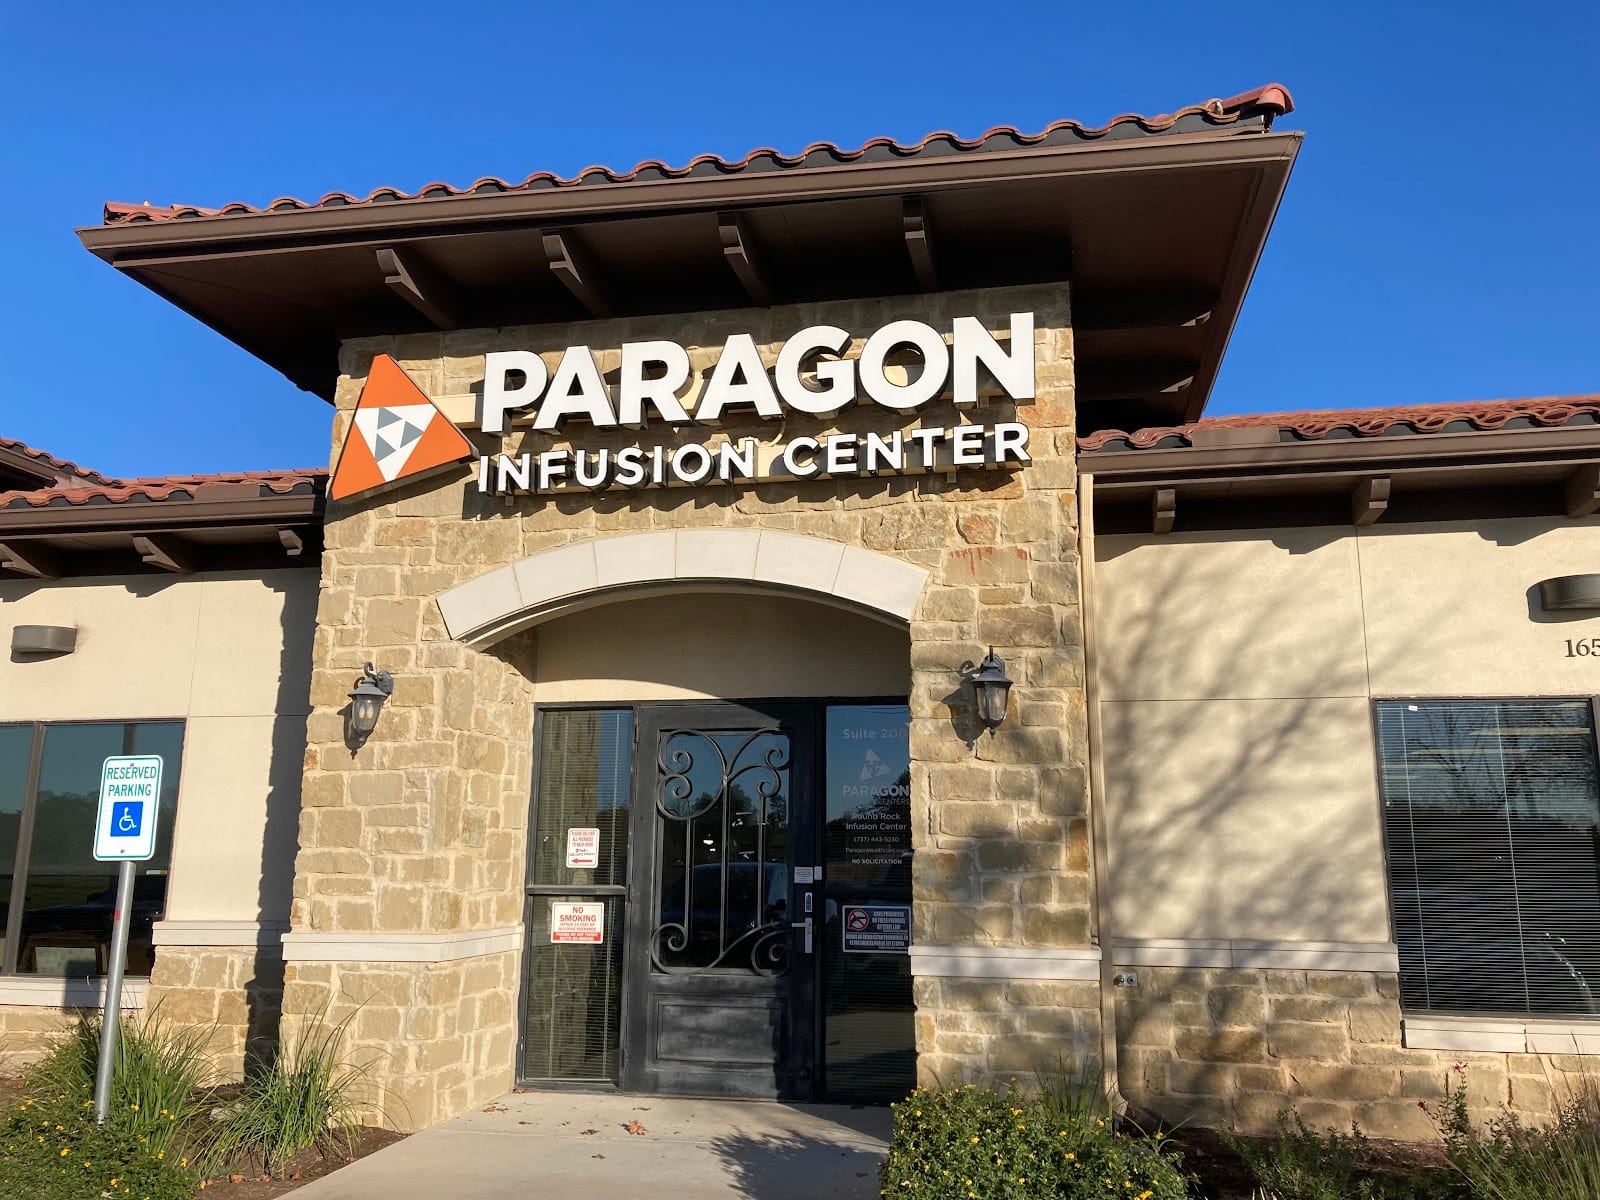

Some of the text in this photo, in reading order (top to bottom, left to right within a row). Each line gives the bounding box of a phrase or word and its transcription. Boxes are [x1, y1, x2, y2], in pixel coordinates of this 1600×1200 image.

[481, 312, 1036, 434] PARAGON
[478, 421, 1031, 494] INFUSION CENTER
[843, 727, 908, 739] Suite 200
[106, 765, 157, 780] RESERVED
[107, 783, 152, 797] PARKING
[842, 784, 910, 797] PARAGON
[880, 812, 901, 820] Rock
[845, 822, 907, 830] Infusion Center
[572, 906, 584, 914] NO
[559, 914, 597, 922] SMOKING
